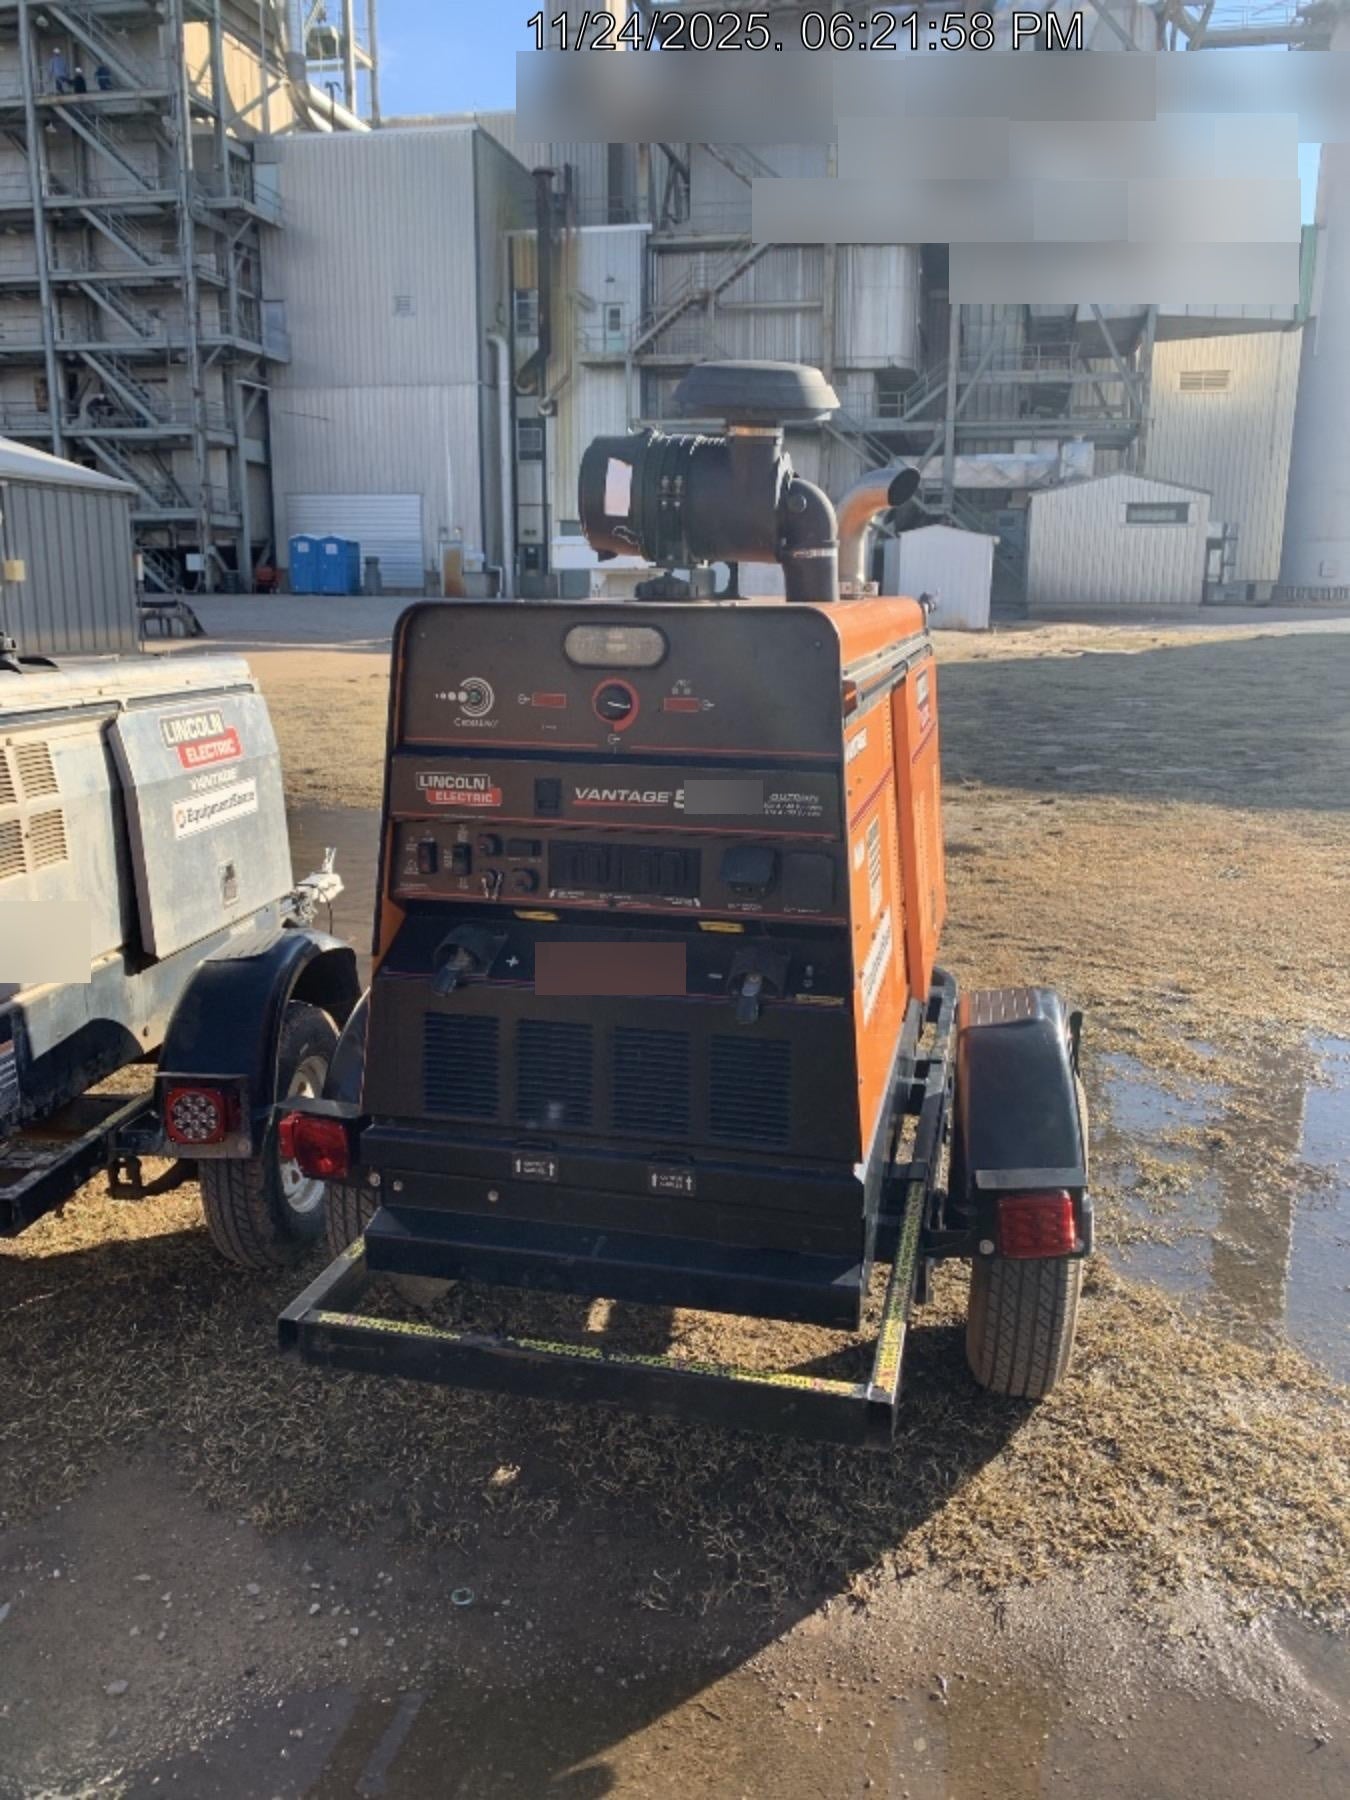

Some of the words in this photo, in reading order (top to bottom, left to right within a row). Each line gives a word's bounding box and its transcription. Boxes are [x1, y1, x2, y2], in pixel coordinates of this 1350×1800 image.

[163, 712, 224, 744] LINCOLN
[185, 738, 237, 763] ELECTRIC
[420, 775, 485, 790] LINCOLN
[435, 791, 493, 803] ELECTRIC
[575, 787, 669, 803] VANTAGE
